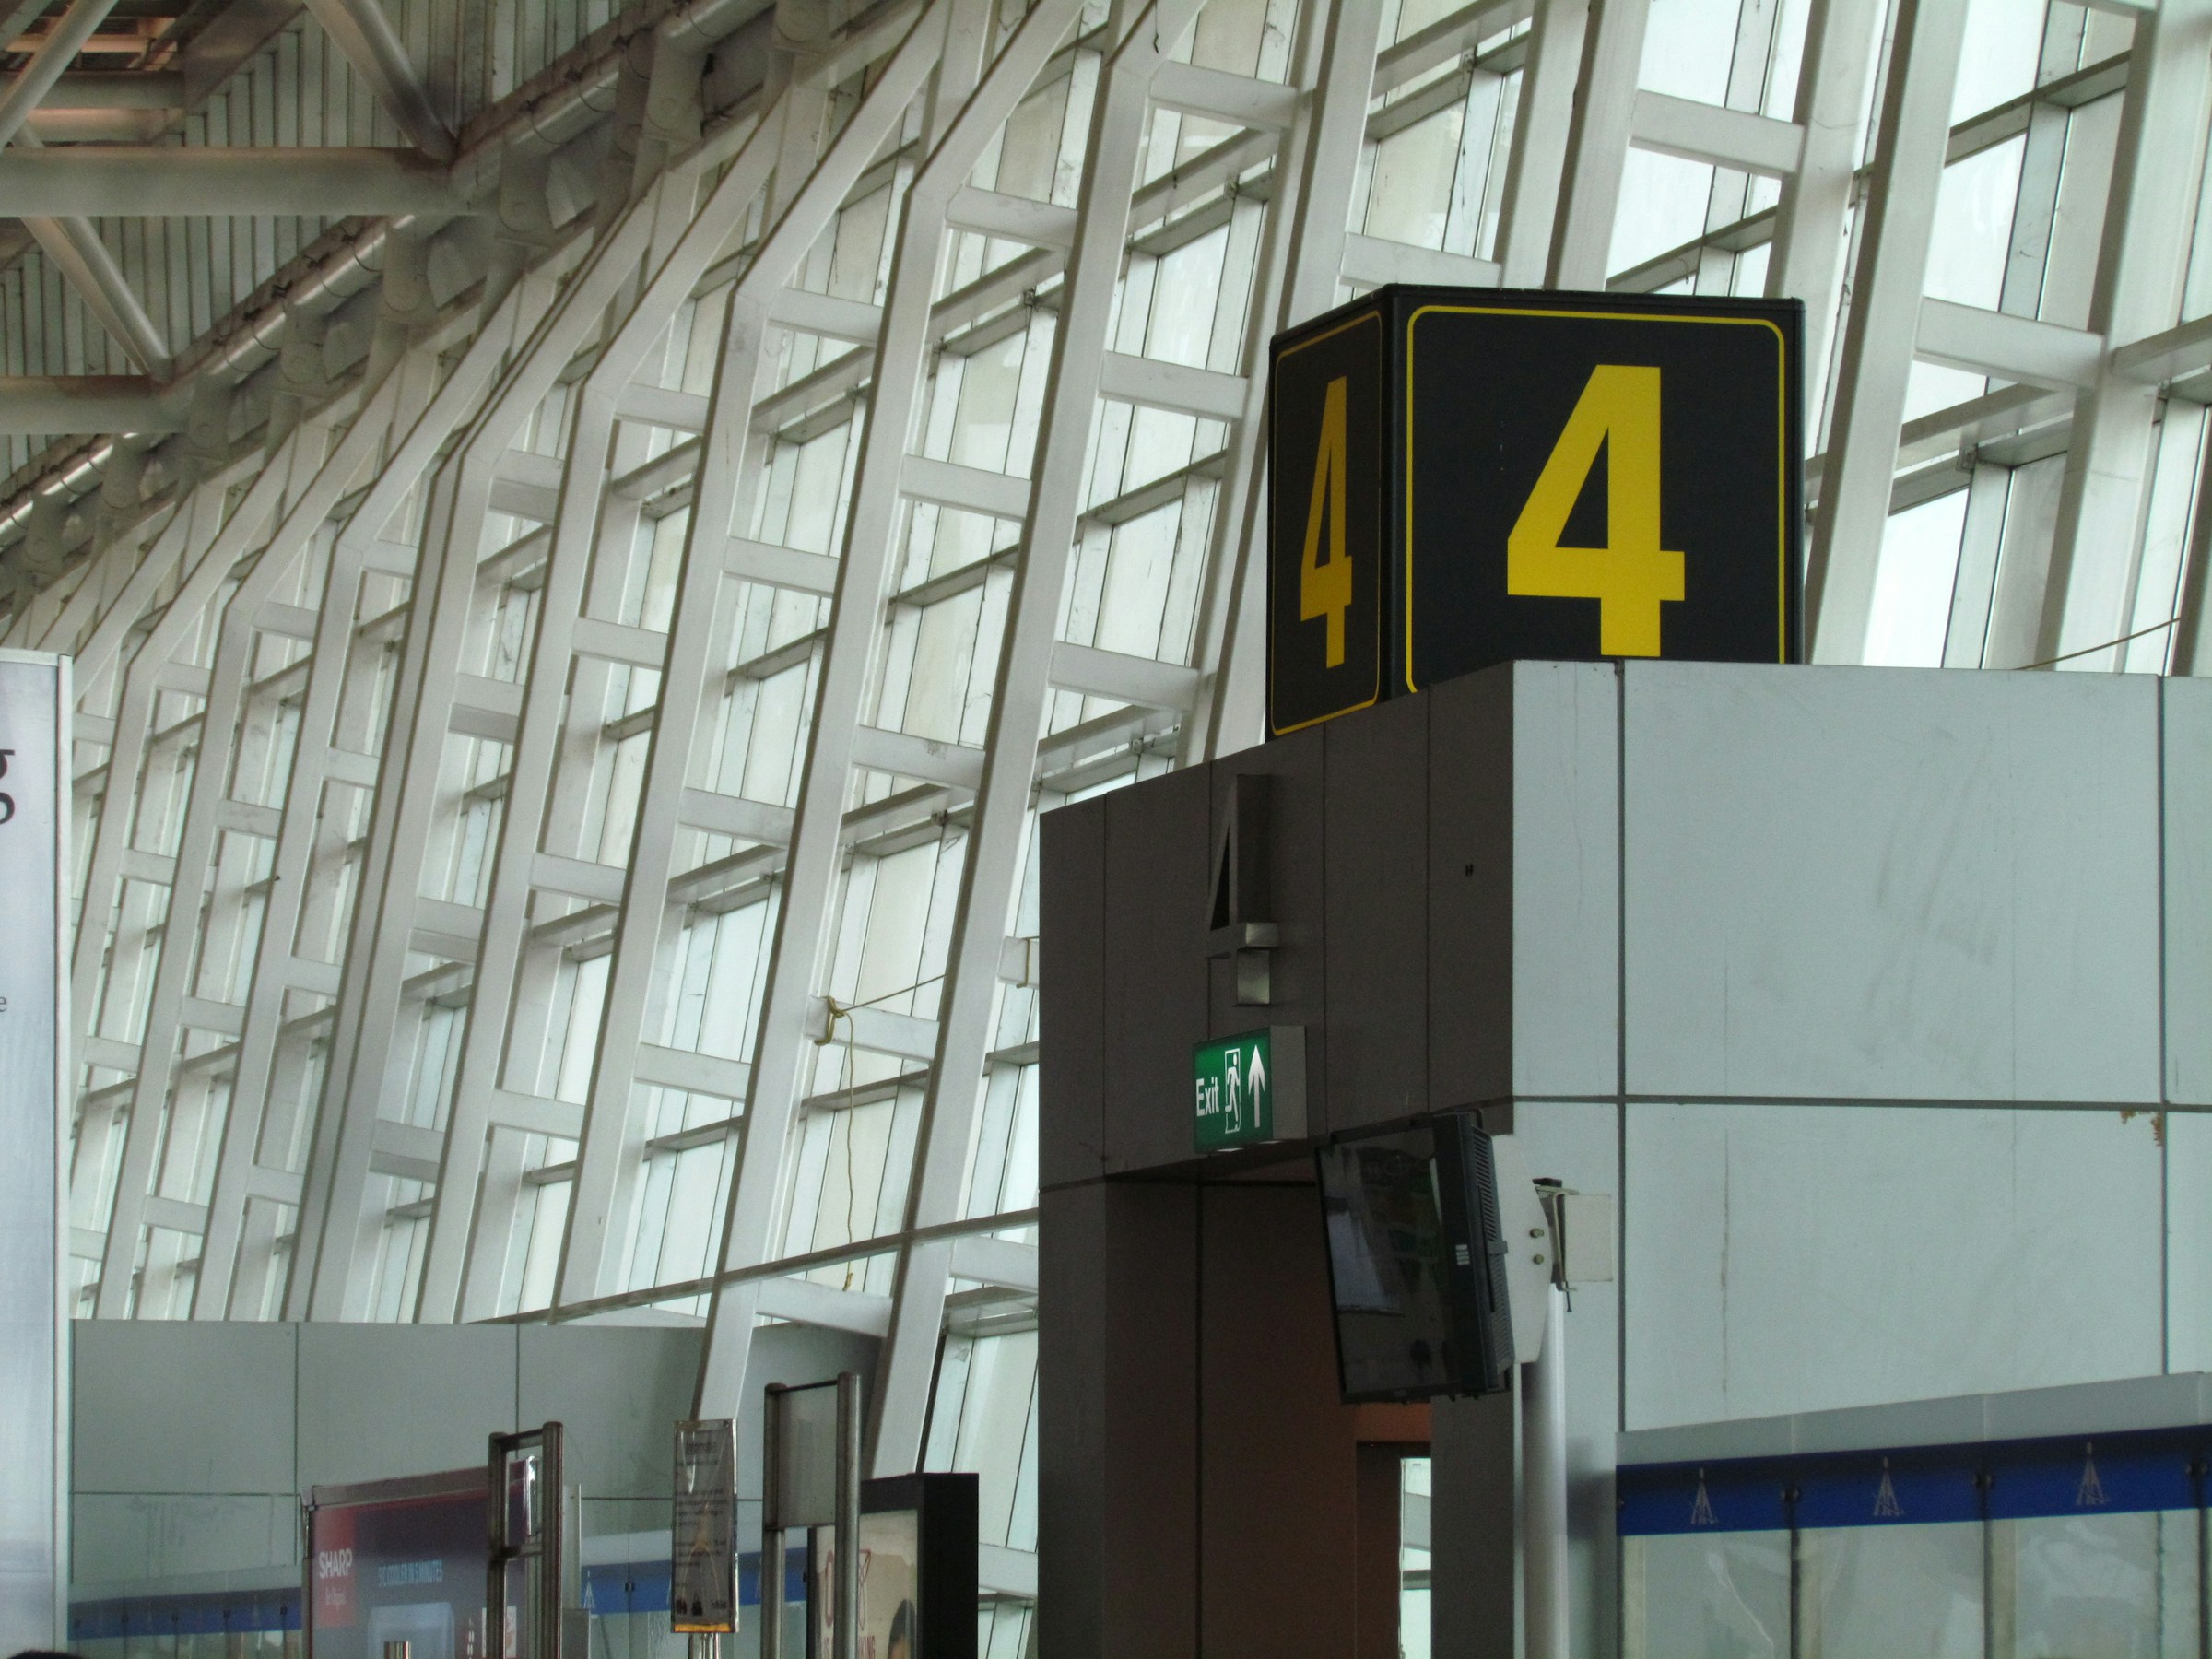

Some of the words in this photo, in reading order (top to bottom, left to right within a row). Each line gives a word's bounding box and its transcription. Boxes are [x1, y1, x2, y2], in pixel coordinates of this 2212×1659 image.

[1300, 376, 1352, 669] 4
[1507, 364, 1685, 657] 4
[1205, 774, 1272, 1007] 4
[1196, 1077, 1219, 1116] Exit
[319, 1548, 353, 1578] SHARP
